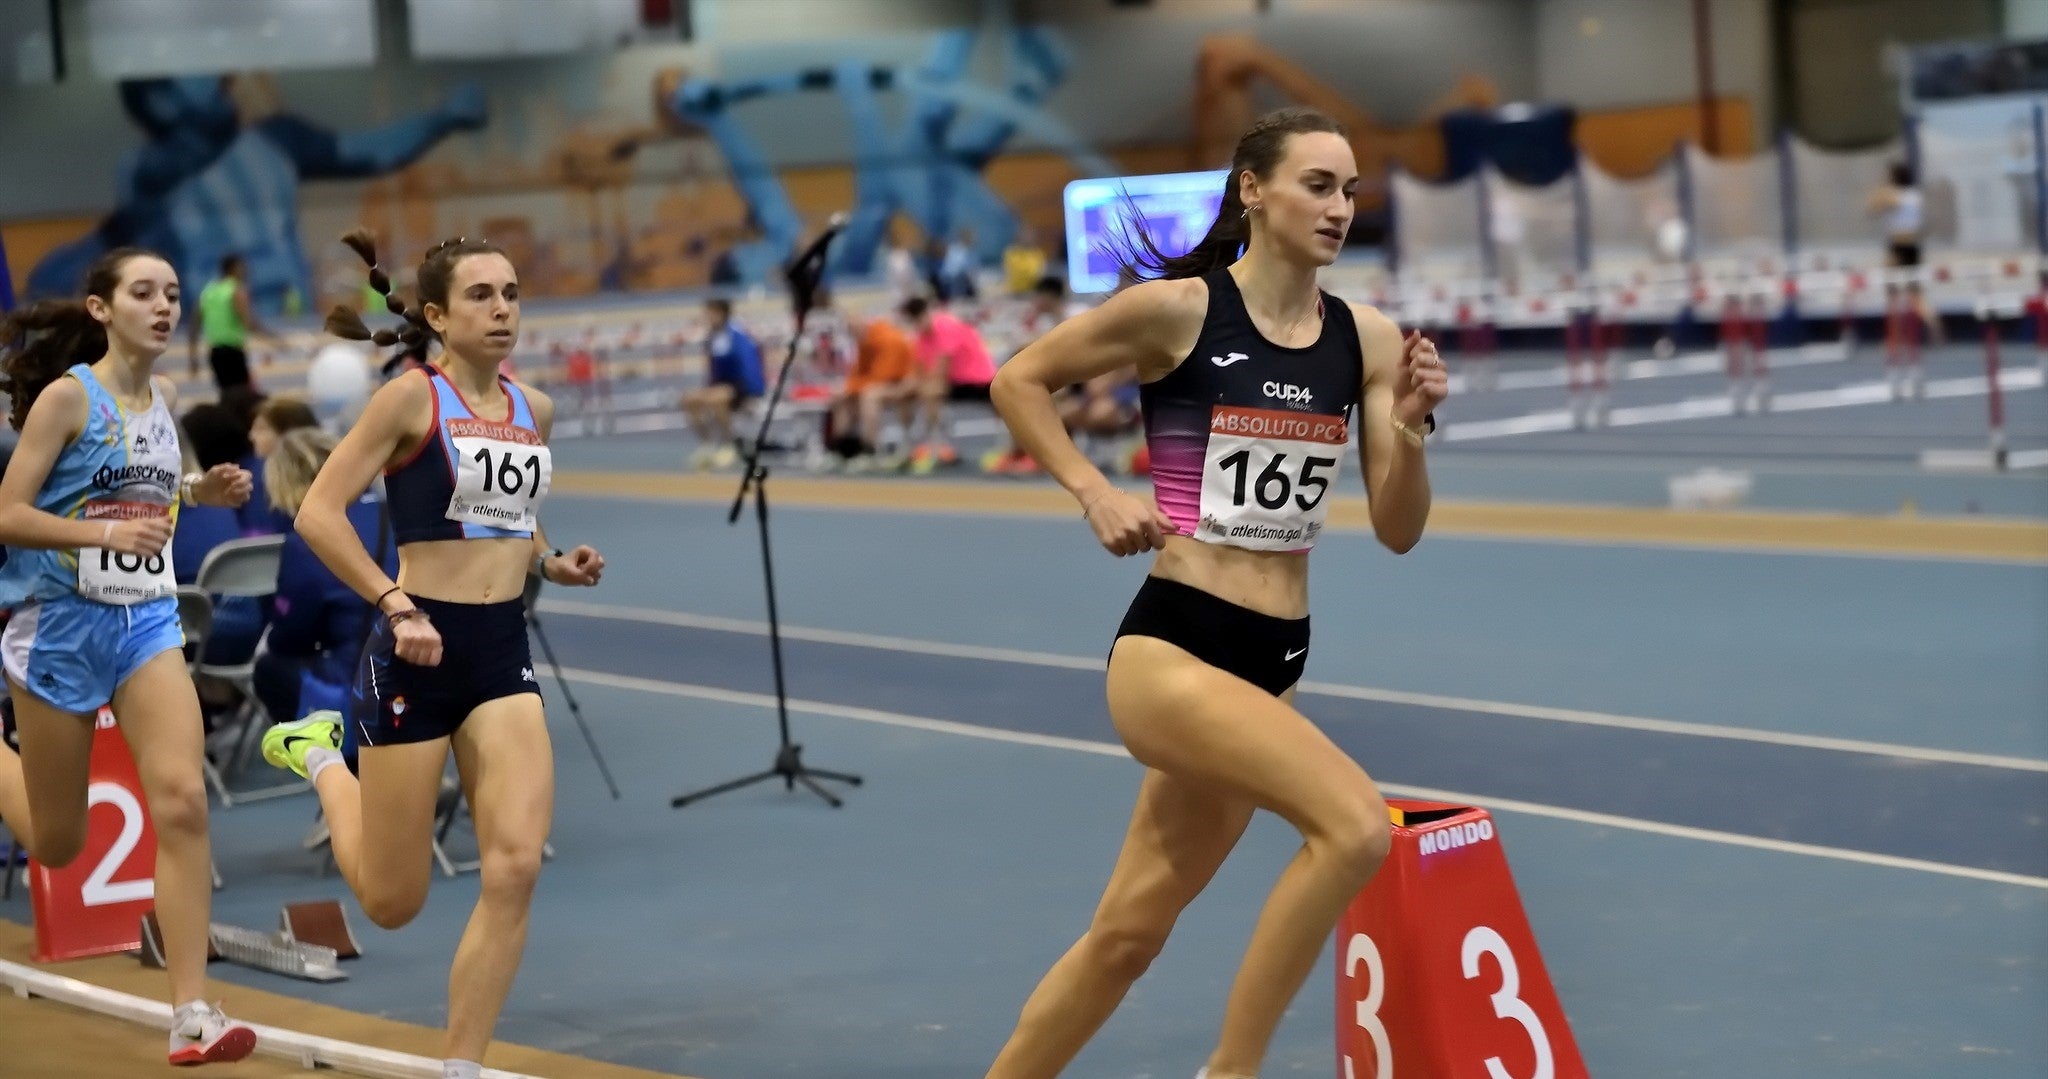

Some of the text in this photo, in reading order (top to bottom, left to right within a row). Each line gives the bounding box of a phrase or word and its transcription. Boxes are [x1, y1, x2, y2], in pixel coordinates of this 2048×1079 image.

[450, 422, 514, 440] ABSOLUTO
[1211, 412, 1309, 438] ABSOLUTO
[92, 465, 176, 491] Quescrem
[474, 448, 540, 499] 161
[1219, 450, 1336, 512] 165
[1231, 524, 1302, 542] atletismo.gal
[81, 781, 154, 907] 2
[1419, 819, 1494, 856] MONDO
[1344, 933, 1393, 1079] 3
[1461, 926, 1555, 1079] 3
